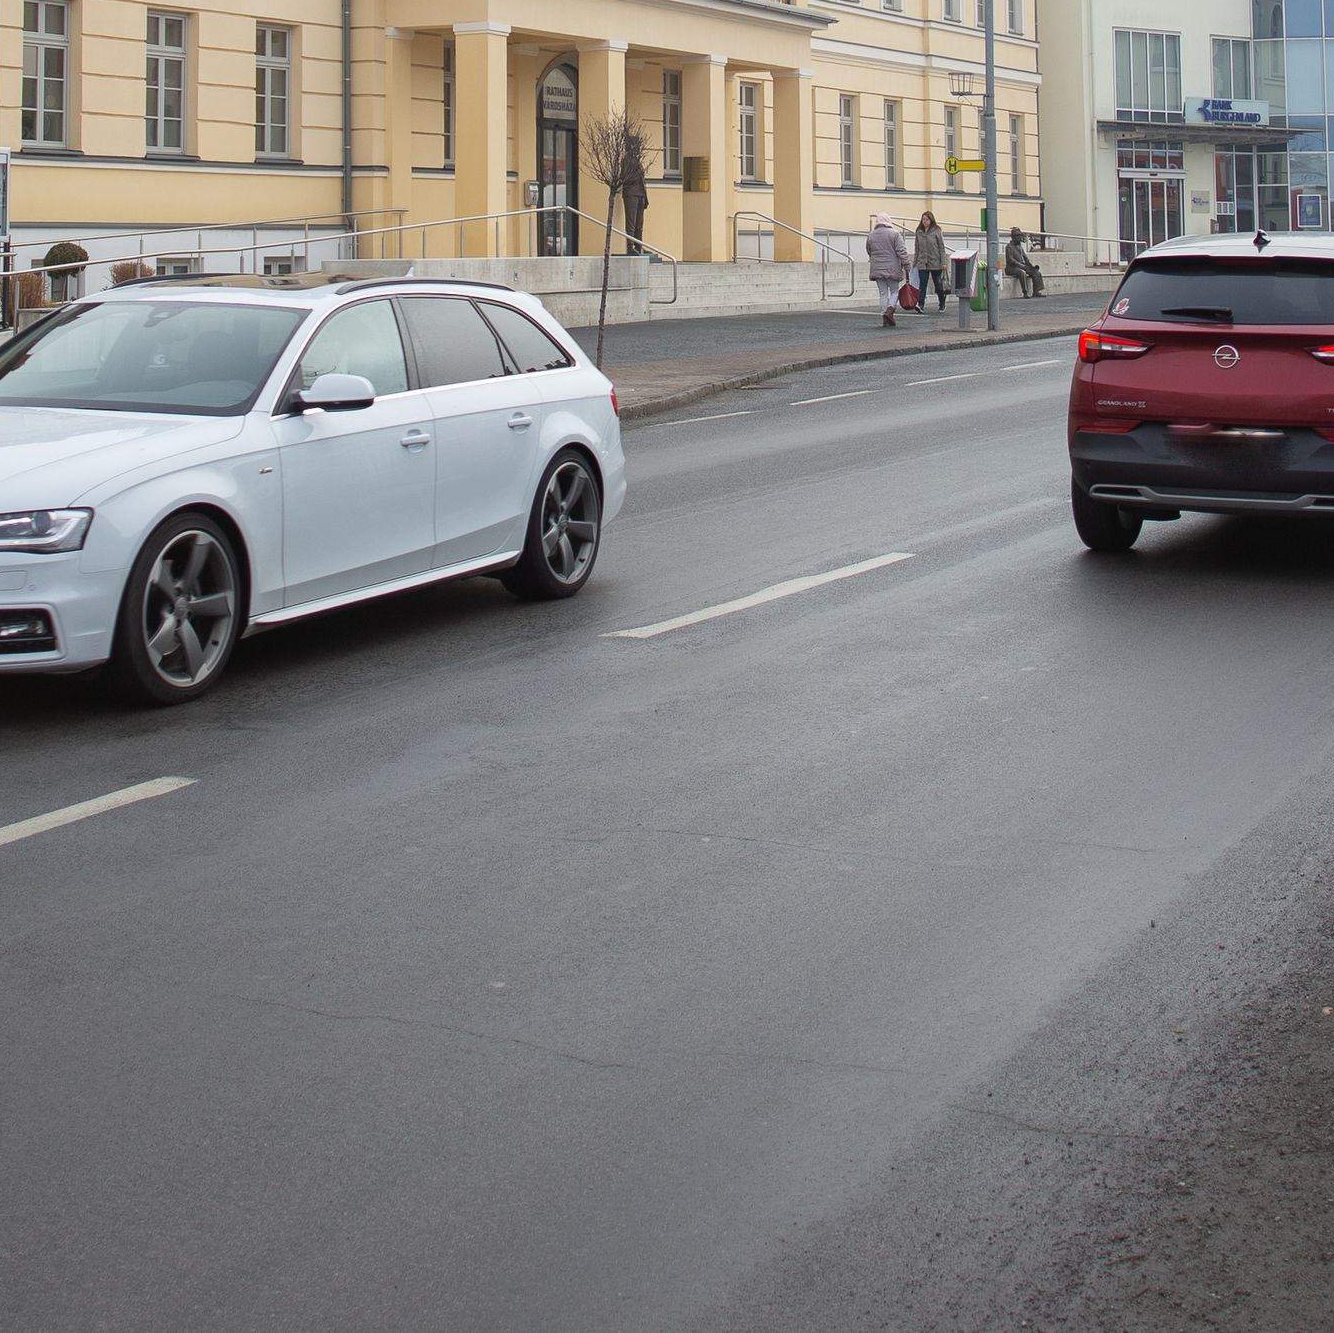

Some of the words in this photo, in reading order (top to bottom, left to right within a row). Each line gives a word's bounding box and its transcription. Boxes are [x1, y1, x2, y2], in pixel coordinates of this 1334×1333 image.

[547, 86, 573, 97] RATHAUS
[1211, 100, 1233, 110] BANK
[1211, 111, 1261, 123] BURGENLAND
[948, 160, 957, 171] H
[1098, 399, 1137, 407] GRANDLAND
